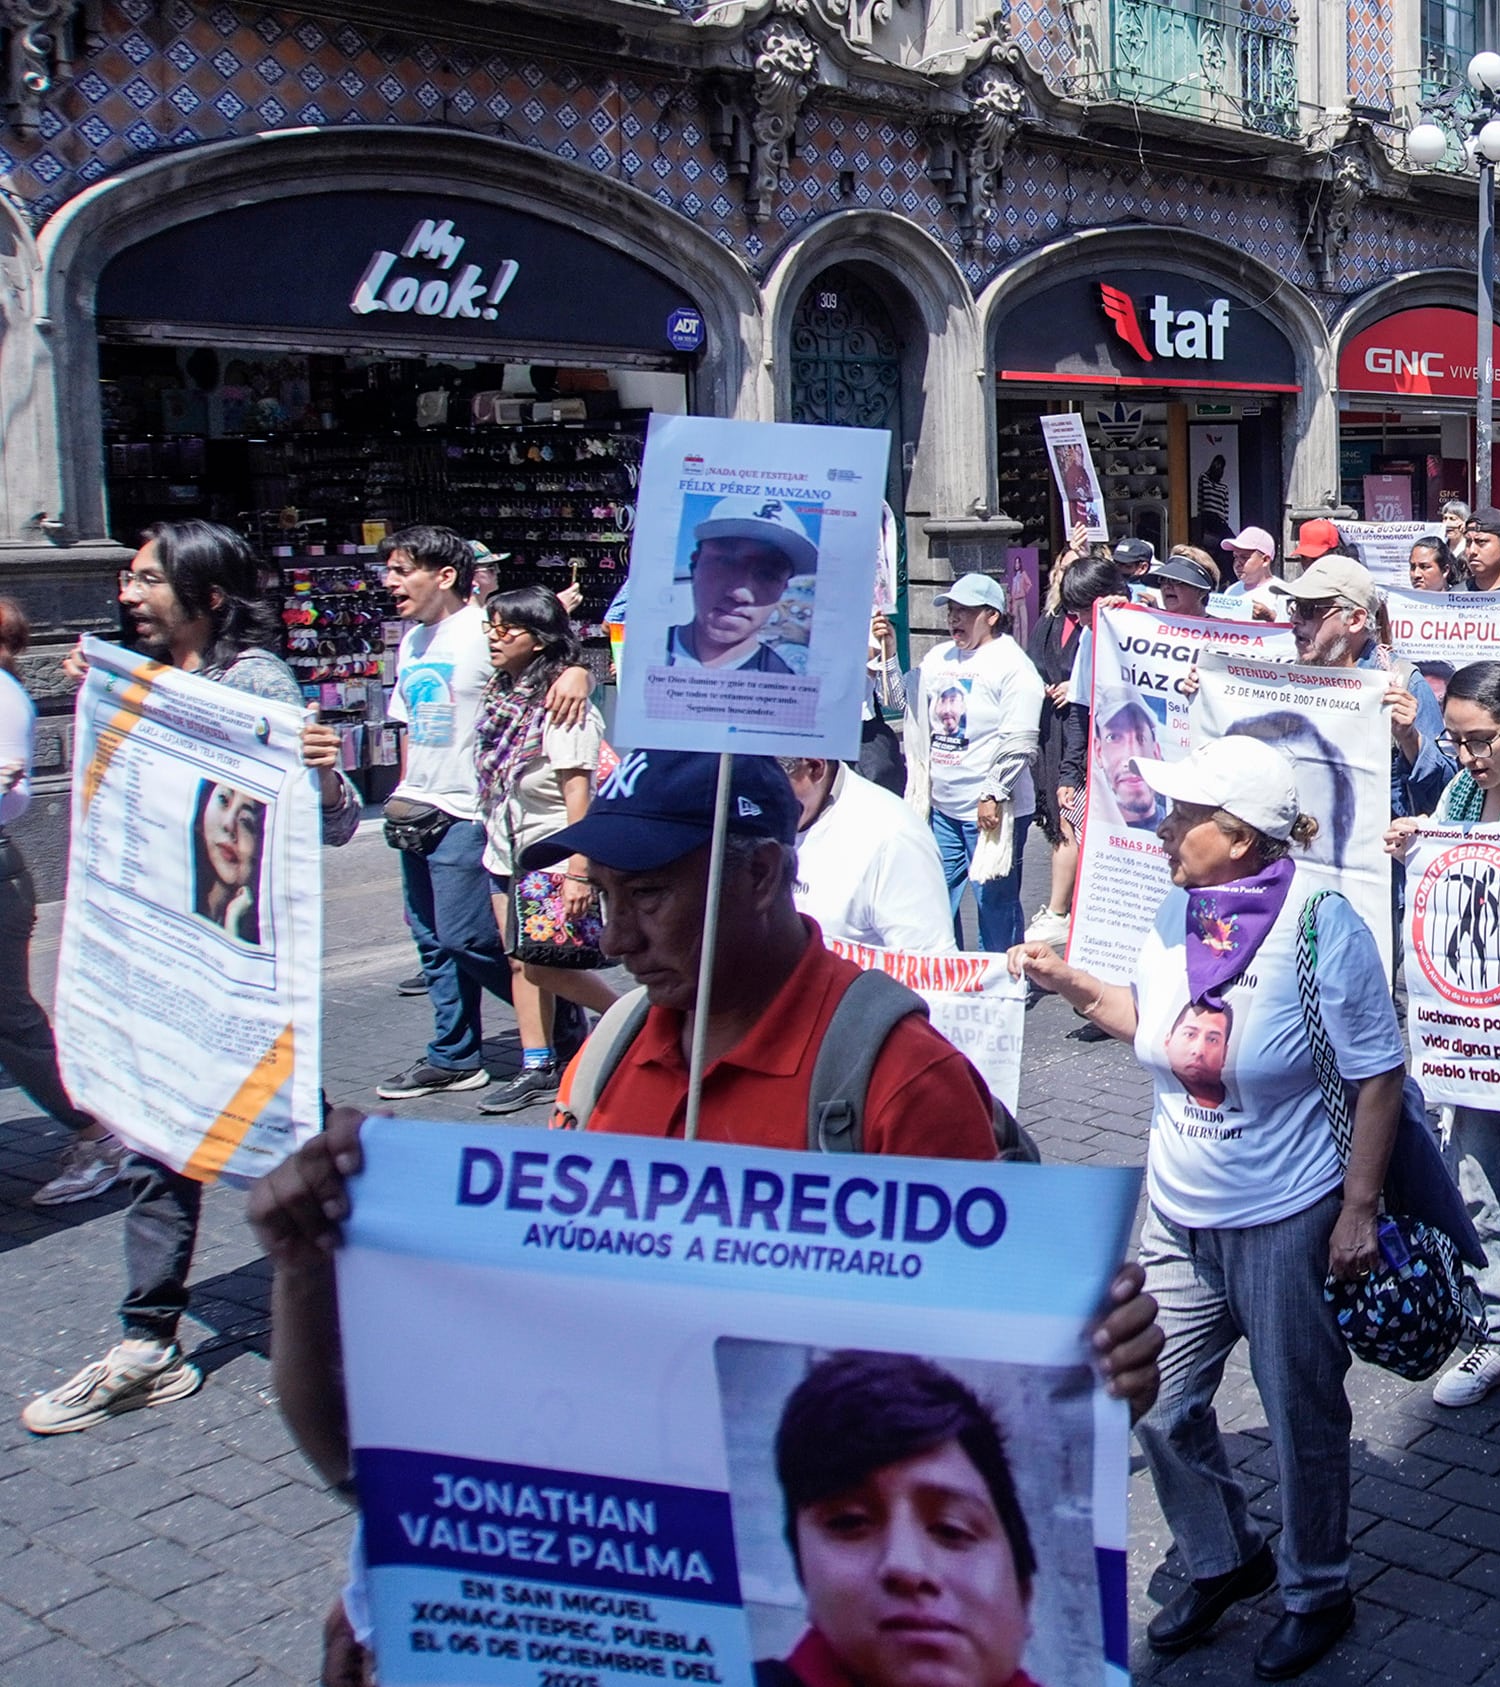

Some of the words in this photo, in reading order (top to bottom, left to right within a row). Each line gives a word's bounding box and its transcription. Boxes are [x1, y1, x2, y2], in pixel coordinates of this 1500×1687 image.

[401, 219, 465, 269] My
[350, 251, 519, 320] Look!
[820, 292, 838, 309] 309
[673, 318, 699, 334] ADT
[1150, 294, 1229, 360] taf
[1365, 347, 1444, 378] GNC
[1450, 366, 1478, 380] VIVE
[739, 470, 759, 479] QUE
[679, 478, 715, 492] FÉLIX
[720, 480, 760, 496] PÉREZ
[764, 486, 831, 500] MANZANO
[1157, 625, 1249, 645] BUSCAMOS
[1253, 636, 1264, 647] A
[1389, 620, 1413, 639] VID
[1118, 636, 1199, 664] JORG
[1121, 664, 1169, 691] DÍAZ
[1227, 665, 1278, 681] DETENIDO
[1288, 672, 1362, 690] DESAPARECIDO
[1224, 685, 1236, 696] 25
[1237, 687, 1249, 698] DE
[1252, 689, 1278, 701] MAYO
[1280, 691, 1292, 703] DE
[1293, 693, 1314, 705] 2007
[1316, 696, 1327, 708] EN
[1329, 698, 1360, 711] OAXACA
[1464, 832, 1473, 840] de
[1418, 1006, 1481, 1029] Luchamos
[1422, 1034, 1449, 1050] vida
[1452, 1040, 1490, 1057] digna
[1422, 1061, 1466, 1080] pueblo
[1183, 1105, 1224, 1126] OSVALDO
[456, 1145, 1008, 1250] DESAPARECIDO
[523, 1221, 672, 1259] AYÚDANOS
[684, 1235, 708, 1263] A
[713, 1237, 923, 1280] ENCONTRARLO
[432, 1473, 659, 1537] JONATHAN
[398, 1512, 559, 1567] VALDEZ
[567, 1537, 713, 1587] PALMA
[461, 1579, 495, 1601] EN
[501, 1584, 554, 1607] SAN
[560, 1591, 657, 1623] MIGUEL
[411, 1602, 607, 1646] XONACATEPEC,
[612, 1625, 715, 1657] PUEBLA
[410, 1631, 442, 1653] EL
[447, 1633, 480, 1656] 06
[487, 1637, 521, 1660] DE
[526, 1641, 666, 1678] DICIEMBRE
[672, 1659, 723, 1685] DEL
